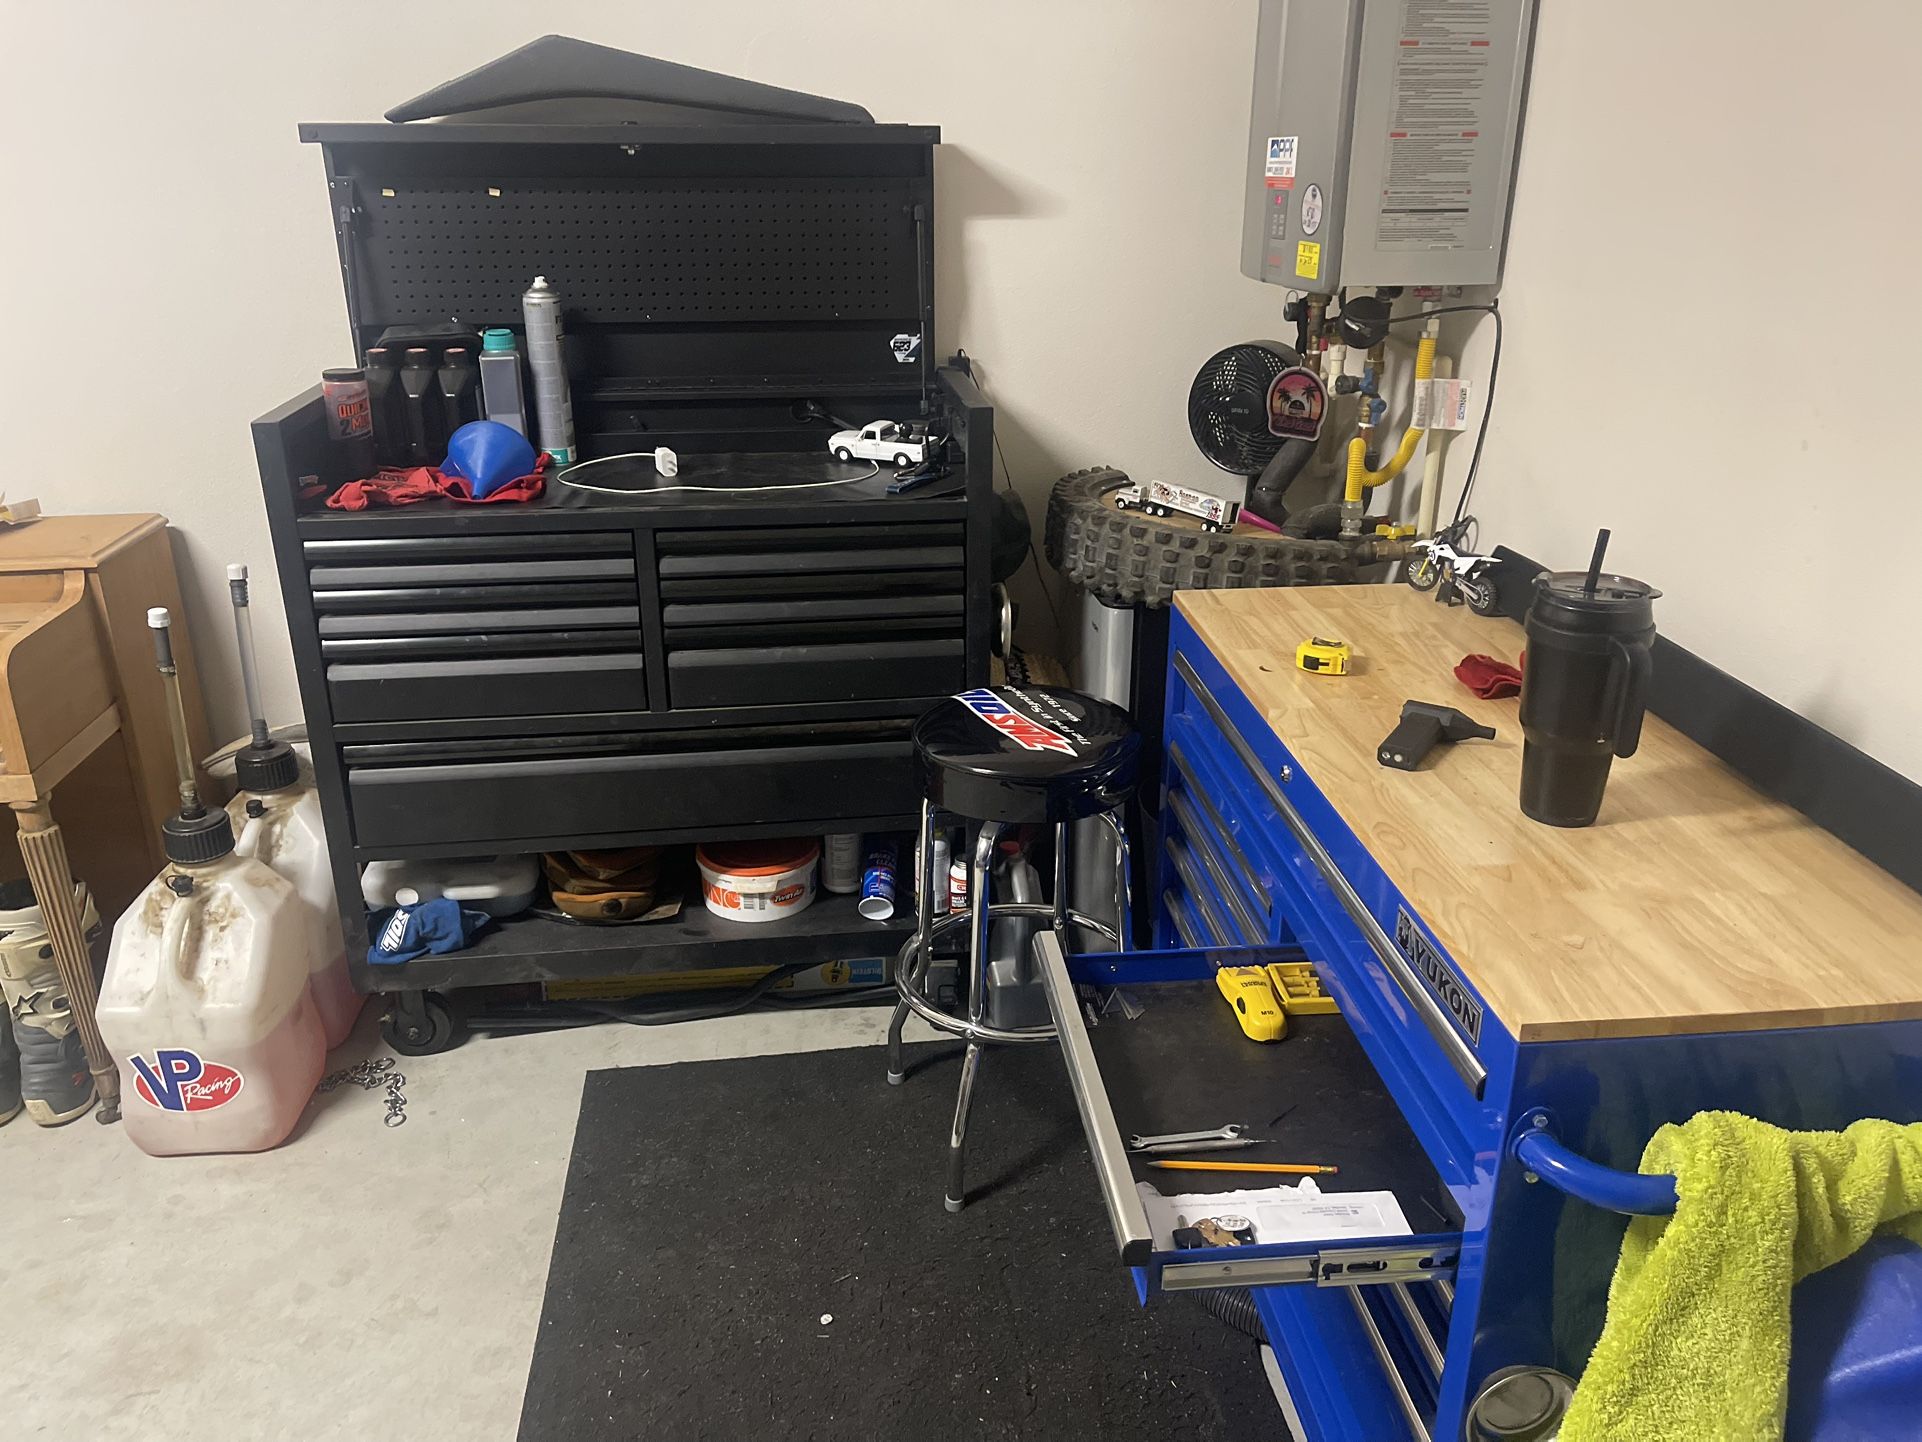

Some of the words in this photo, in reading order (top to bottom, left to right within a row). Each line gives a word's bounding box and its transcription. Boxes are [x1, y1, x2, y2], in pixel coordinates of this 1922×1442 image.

[953, 688, 1078, 757] AMSOIL
[1412, 939, 1477, 1035] YUKON
[127, 1048, 206, 1112] VP
[184, 1075, 240, 1104] Racing
